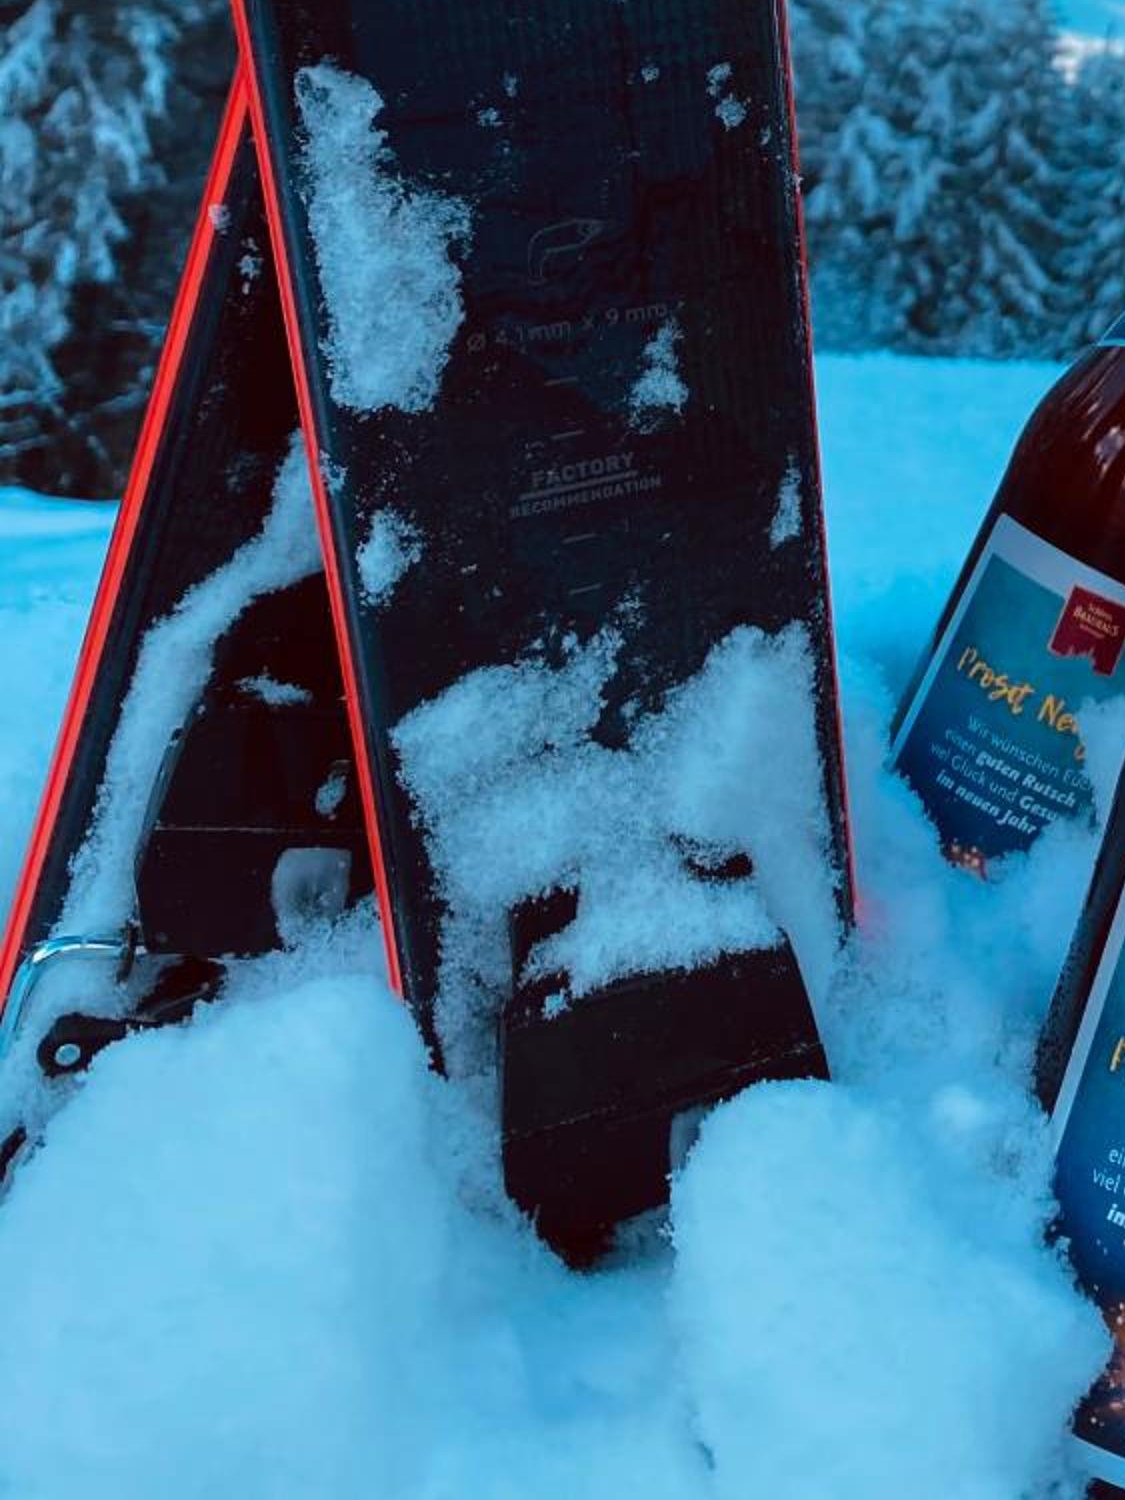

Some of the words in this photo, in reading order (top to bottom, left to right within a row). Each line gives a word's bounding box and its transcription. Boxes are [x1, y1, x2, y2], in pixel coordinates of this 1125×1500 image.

[530, 451, 637, 488] FACTORY
[957, 647, 1034, 714] Prost
[975, 751, 1021, 782] guten
[1022, 771, 1077, 809] Rutsch
[990, 730, 1059, 780] wünschen
[935, 770, 954, 792] im
[955, 782, 1002, 818] neuen
[996, 803, 1038, 836] Jahr
[1092, 1167, 1121, 1195] viel
